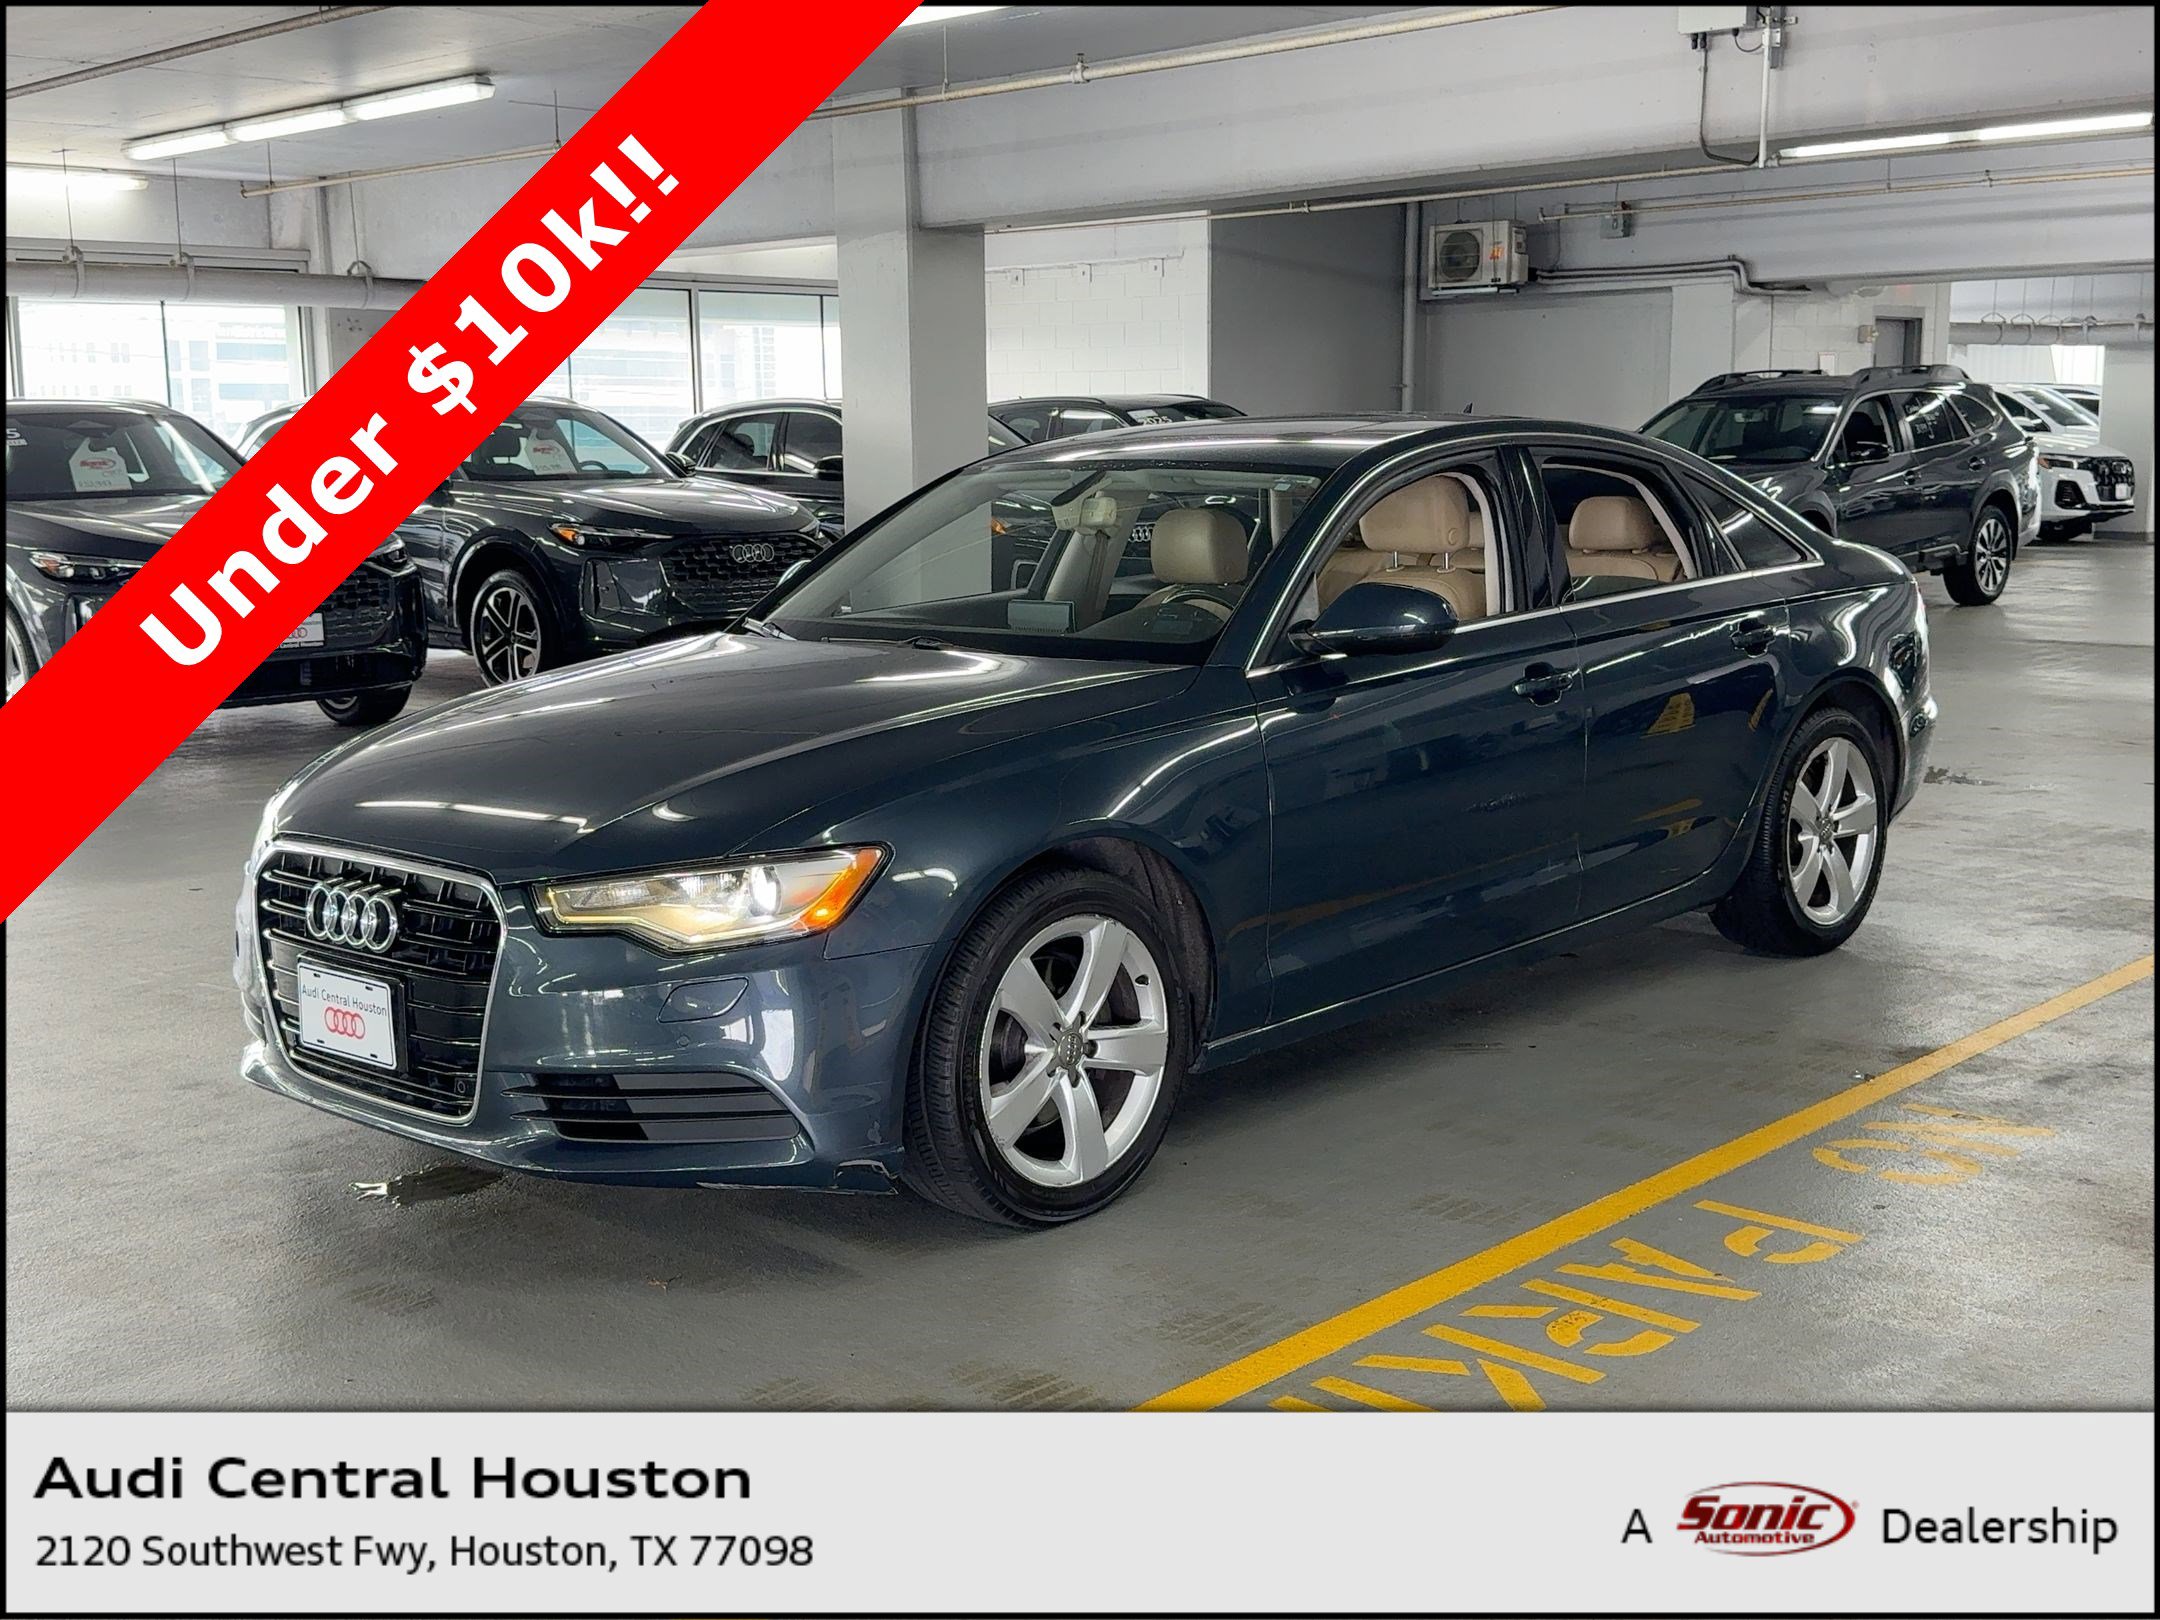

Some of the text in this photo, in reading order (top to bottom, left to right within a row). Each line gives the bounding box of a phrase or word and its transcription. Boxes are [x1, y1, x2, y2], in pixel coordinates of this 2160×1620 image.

[302, 983, 387, 1017] Audi Central Houston
[1812, 1102, 2057, 1186] NO
